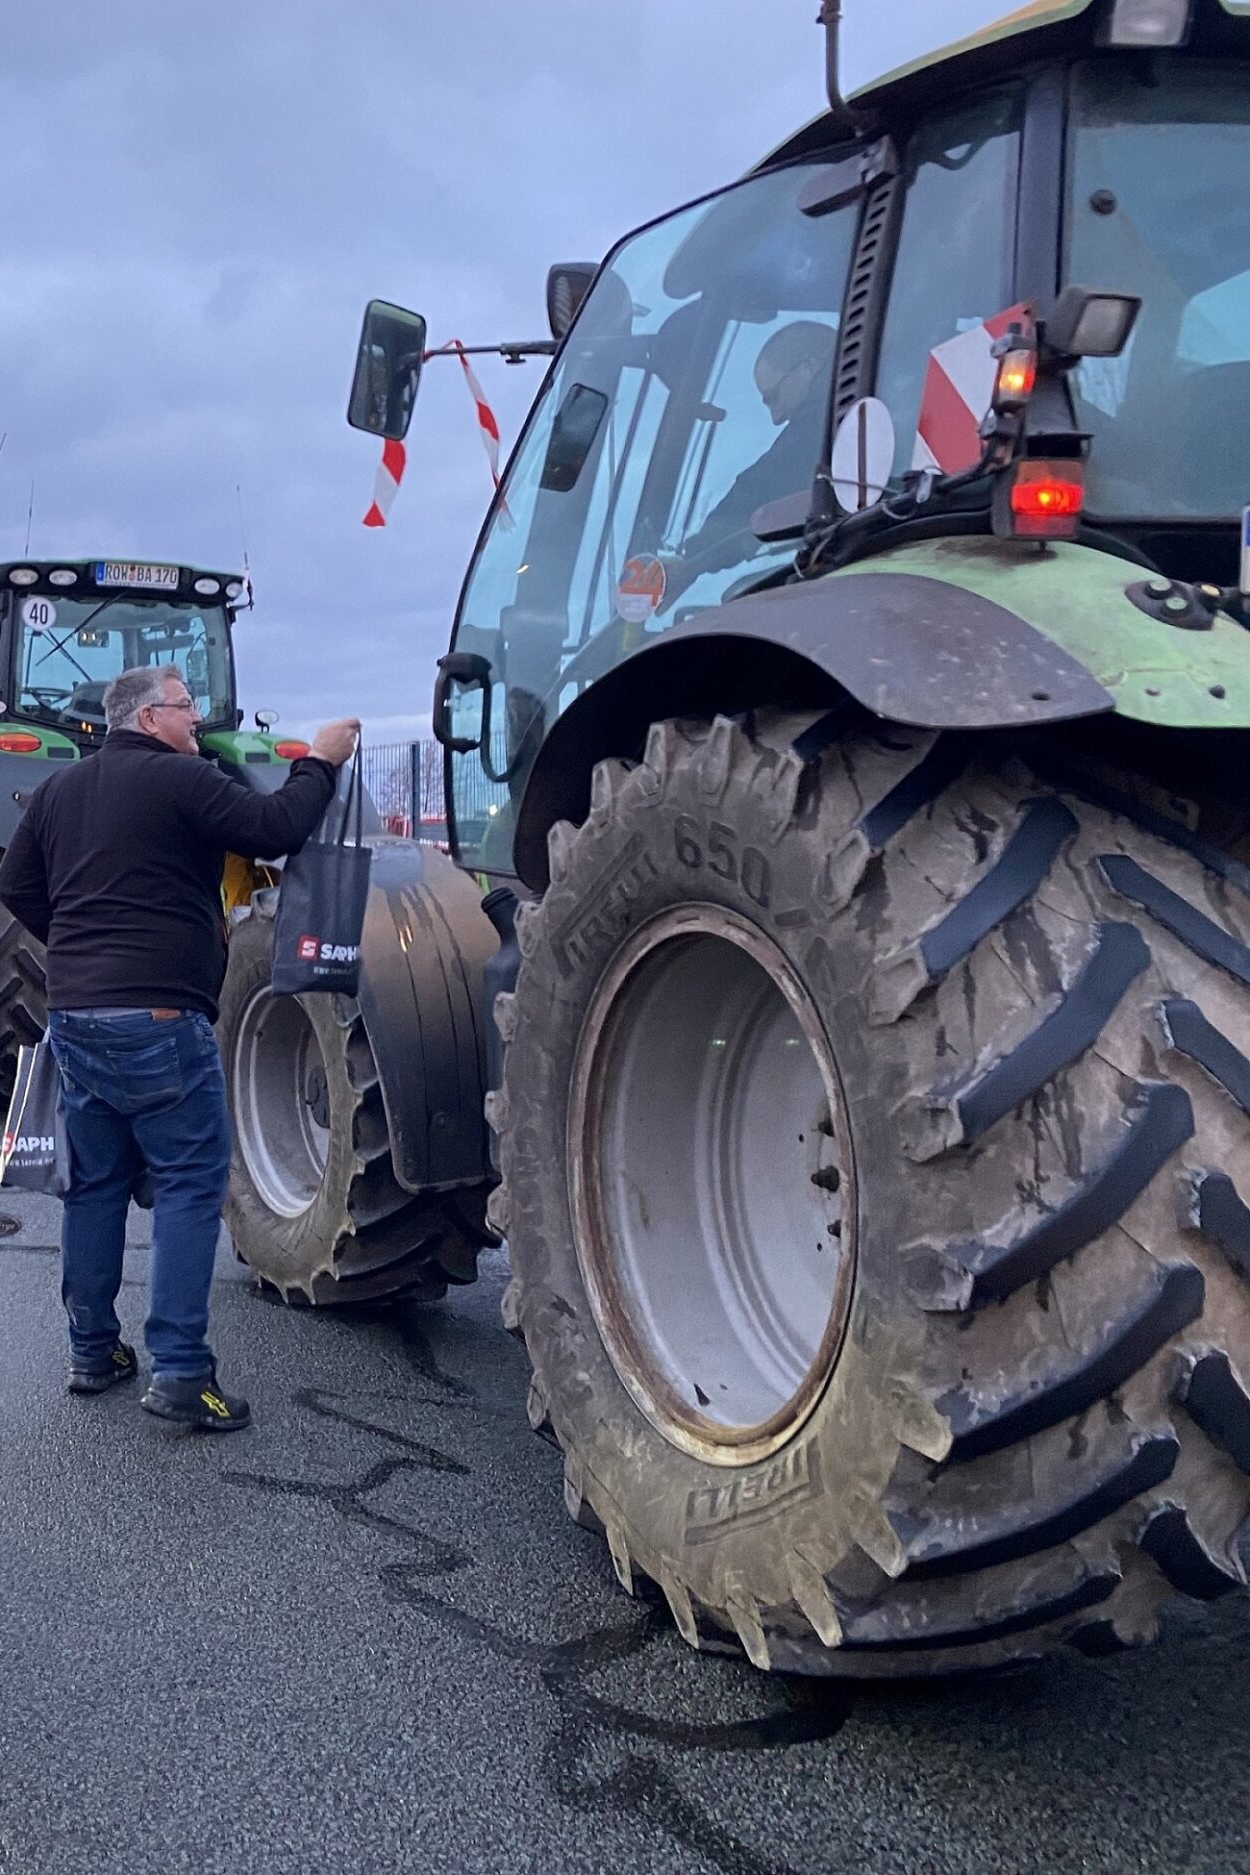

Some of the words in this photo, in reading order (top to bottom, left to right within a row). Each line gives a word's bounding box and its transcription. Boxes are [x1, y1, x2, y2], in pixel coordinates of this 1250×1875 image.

[137, 567, 152, 582] BA
[155, 568, 177, 584] 170
[30, 603, 48, 624] 40
[13, 1136, 55, 1152] APH
